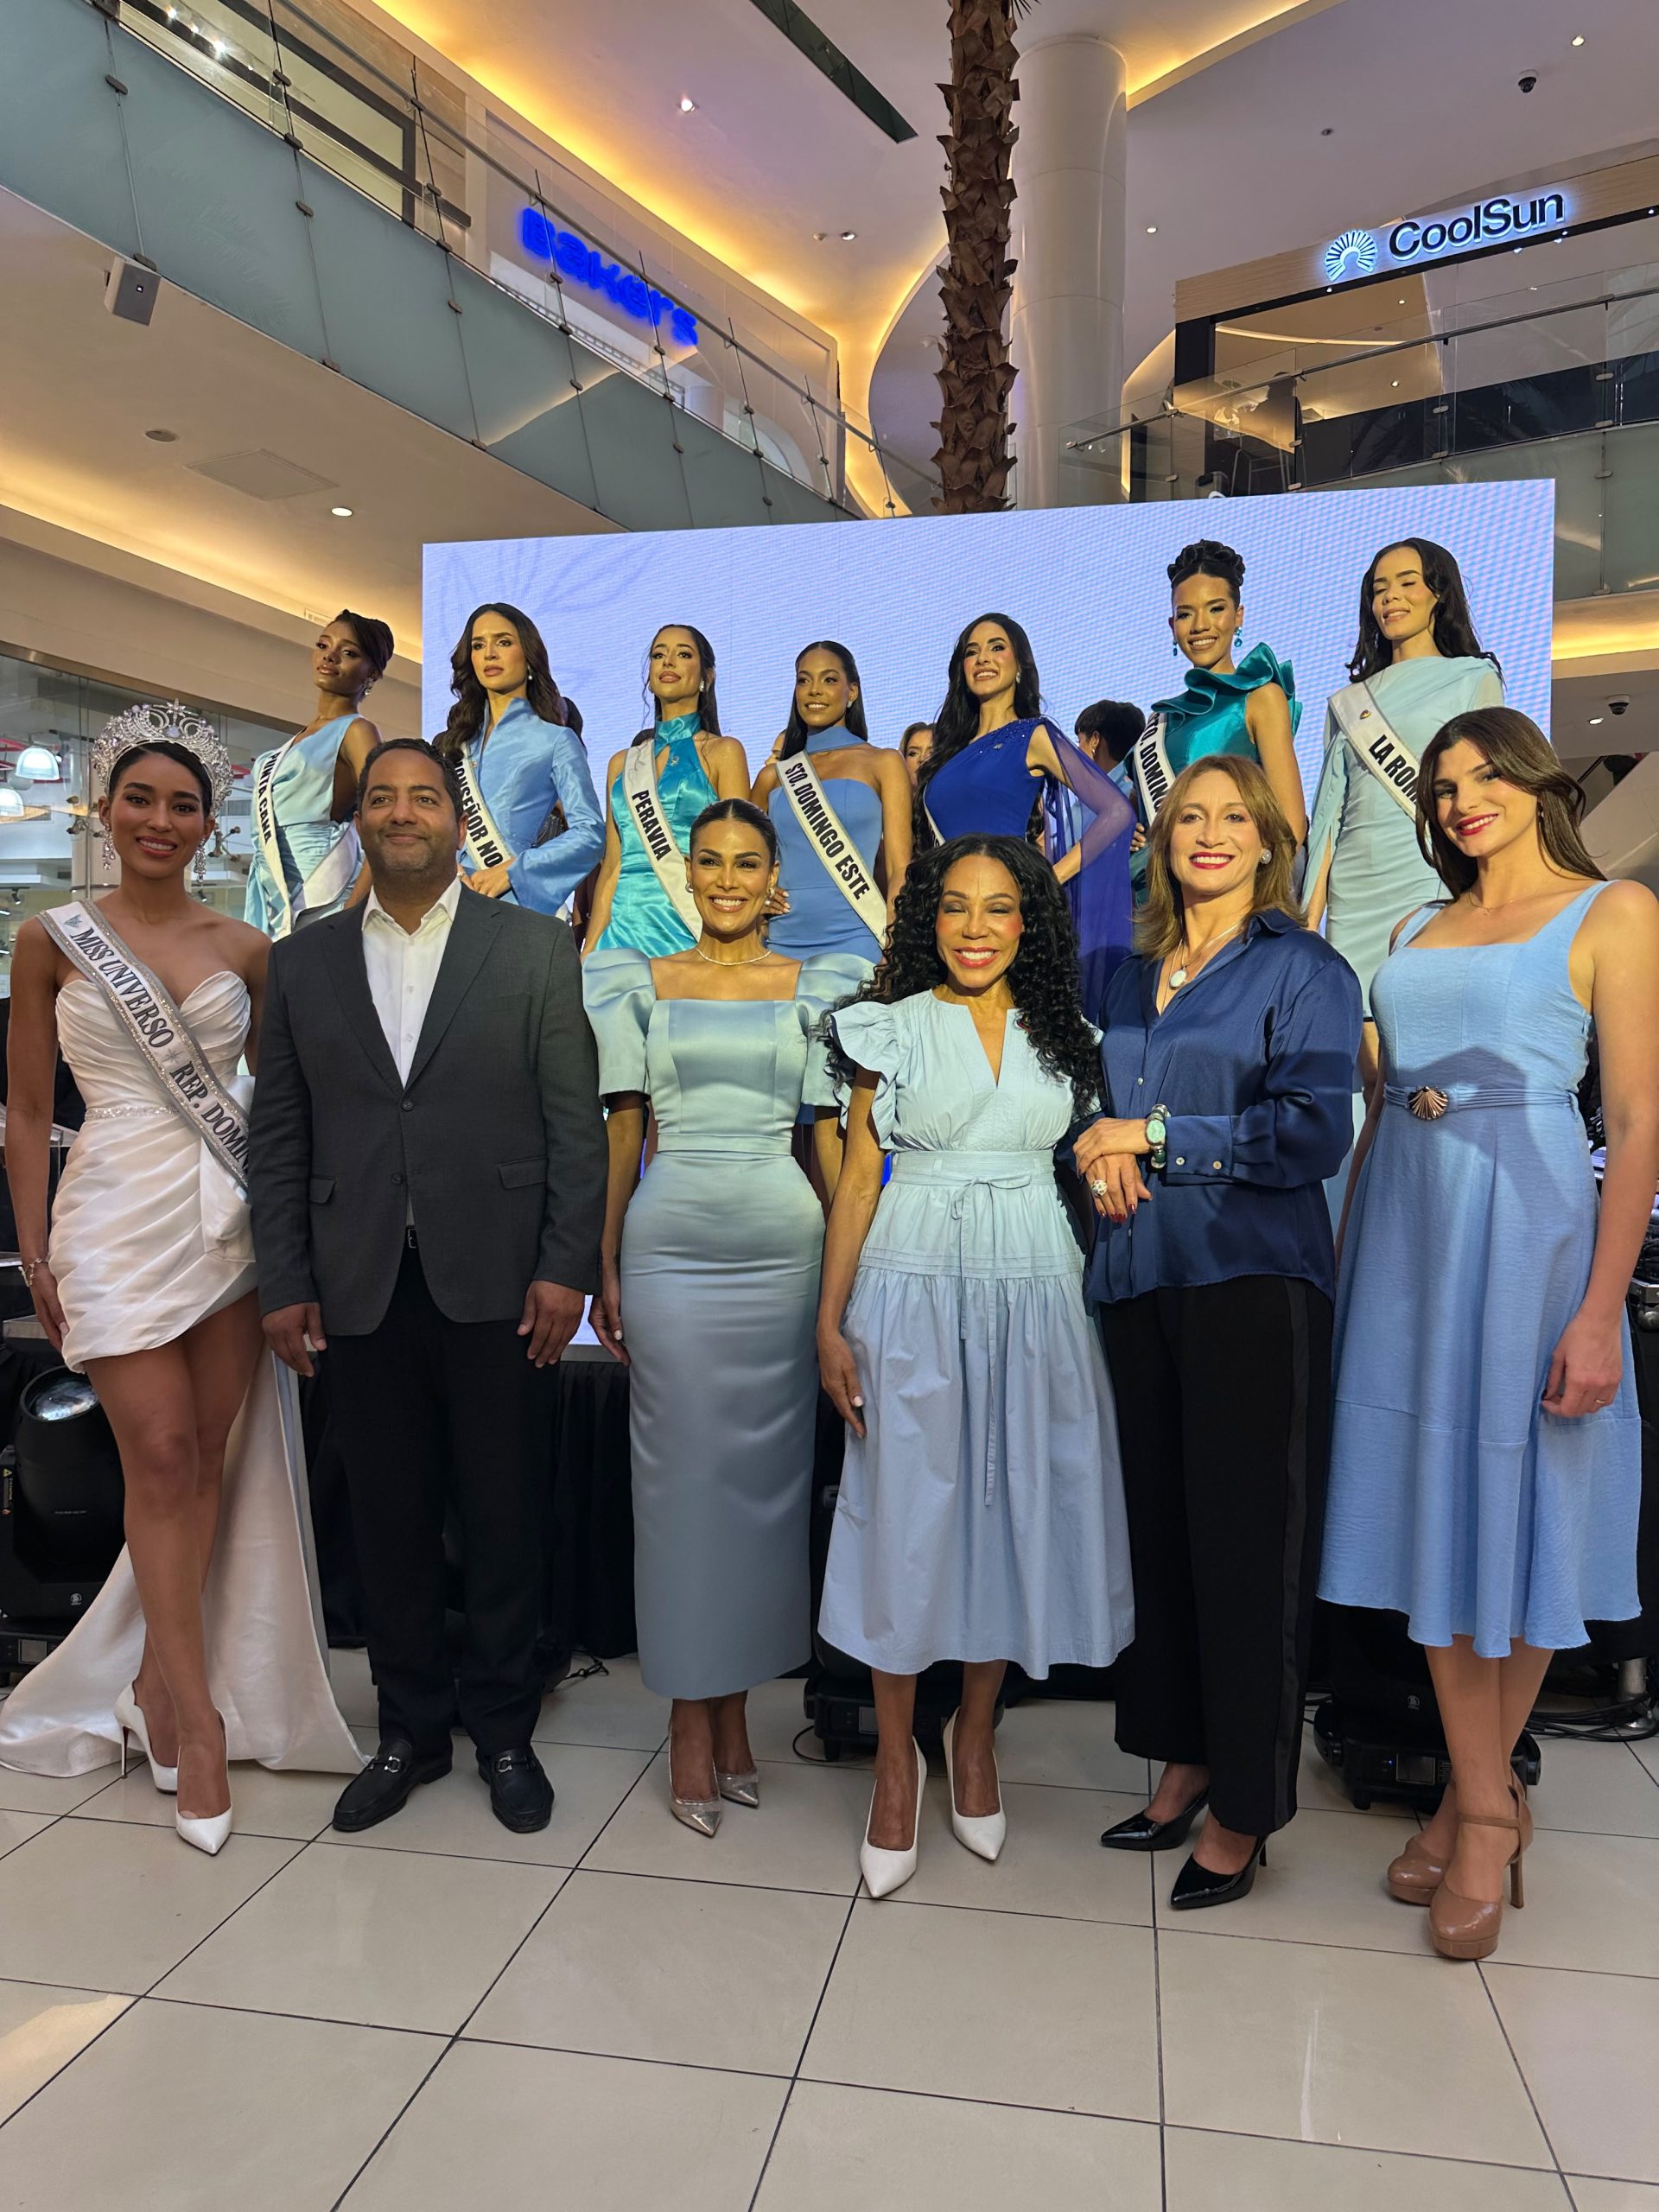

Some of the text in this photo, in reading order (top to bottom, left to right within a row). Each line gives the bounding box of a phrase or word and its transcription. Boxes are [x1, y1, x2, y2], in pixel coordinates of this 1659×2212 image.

[1389, 194, 1564, 258] CoolSun
[523, 207, 698, 346] Bakers
[259, 752, 281, 845] PUNTA CANA
[1369, 734, 1417, 805] LA ROM
[632, 790, 671, 861] PERAVIA
[785, 762, 870, 900] STO. DOMINGO ESTE
[69, 927, 114, 961] MISS
[99, 959, 174, 1047] UNIVERSO
[169, 1061, 208, 1109] REP.
